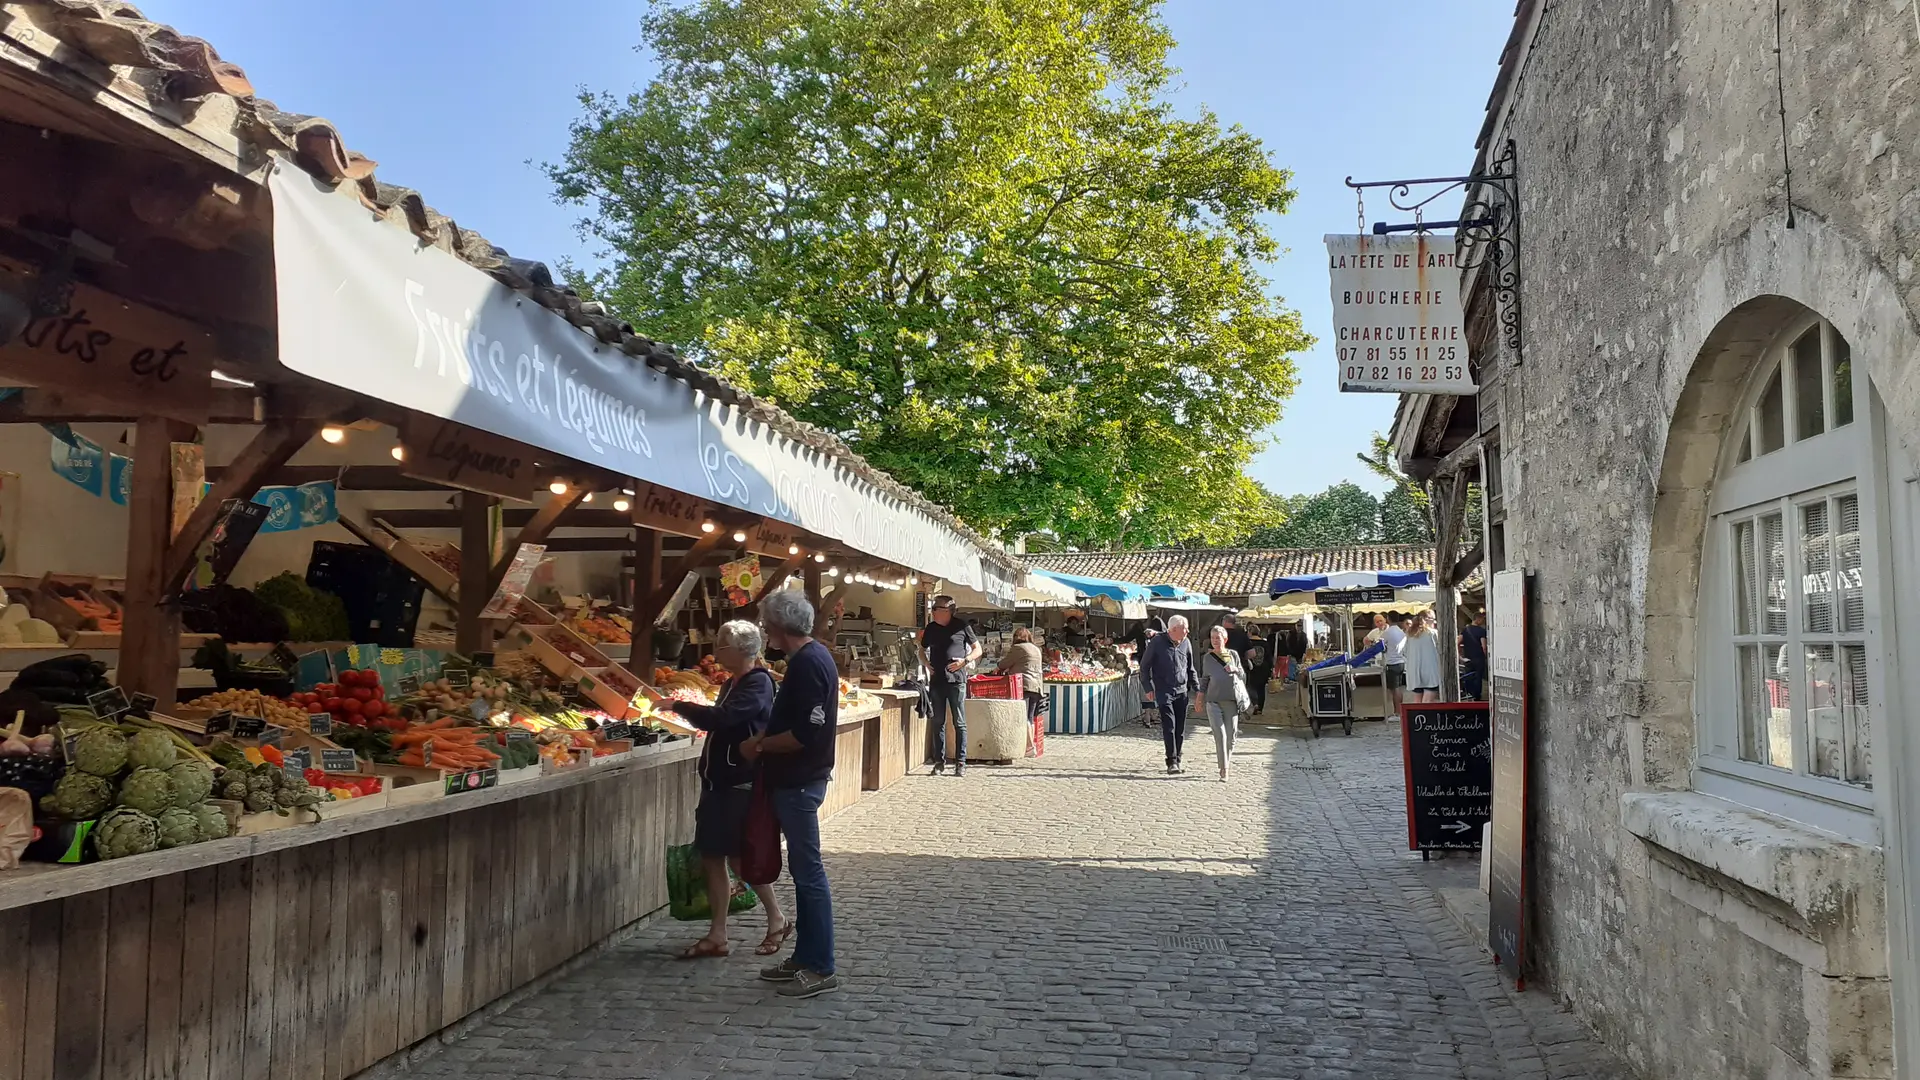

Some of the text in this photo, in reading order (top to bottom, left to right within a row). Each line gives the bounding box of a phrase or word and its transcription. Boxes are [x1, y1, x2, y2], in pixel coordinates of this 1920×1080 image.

[1331, 252, 1456, 269] LA TETE DE L'ART
[1343, 290, 1442, 305] BOUCHERIE
[1340, 326, 1458, 341] CHARCUTERIE
[404, 278, 513, 403] Fruits
[516, 345, 550, 420] et
[1340, 347, 1455, 361] 07 81 55 11 25
[130, 340, 188, 382] et
[1347, 366, 1462, 380] 07 82 16 23 53
[763, 442, 843, 537] Jardins
[1414, 713, 1453, 732] Poulets
[1429, 732, 1468, 745] Fermier
[1431, 745, 1461, 758] Entier
[1441, 760, 1466, 772] Poulet
[1446, 786, 1455, 796] de
[1427, 807, 1440, 817] La
[1458, 807, 1466, 816] de
